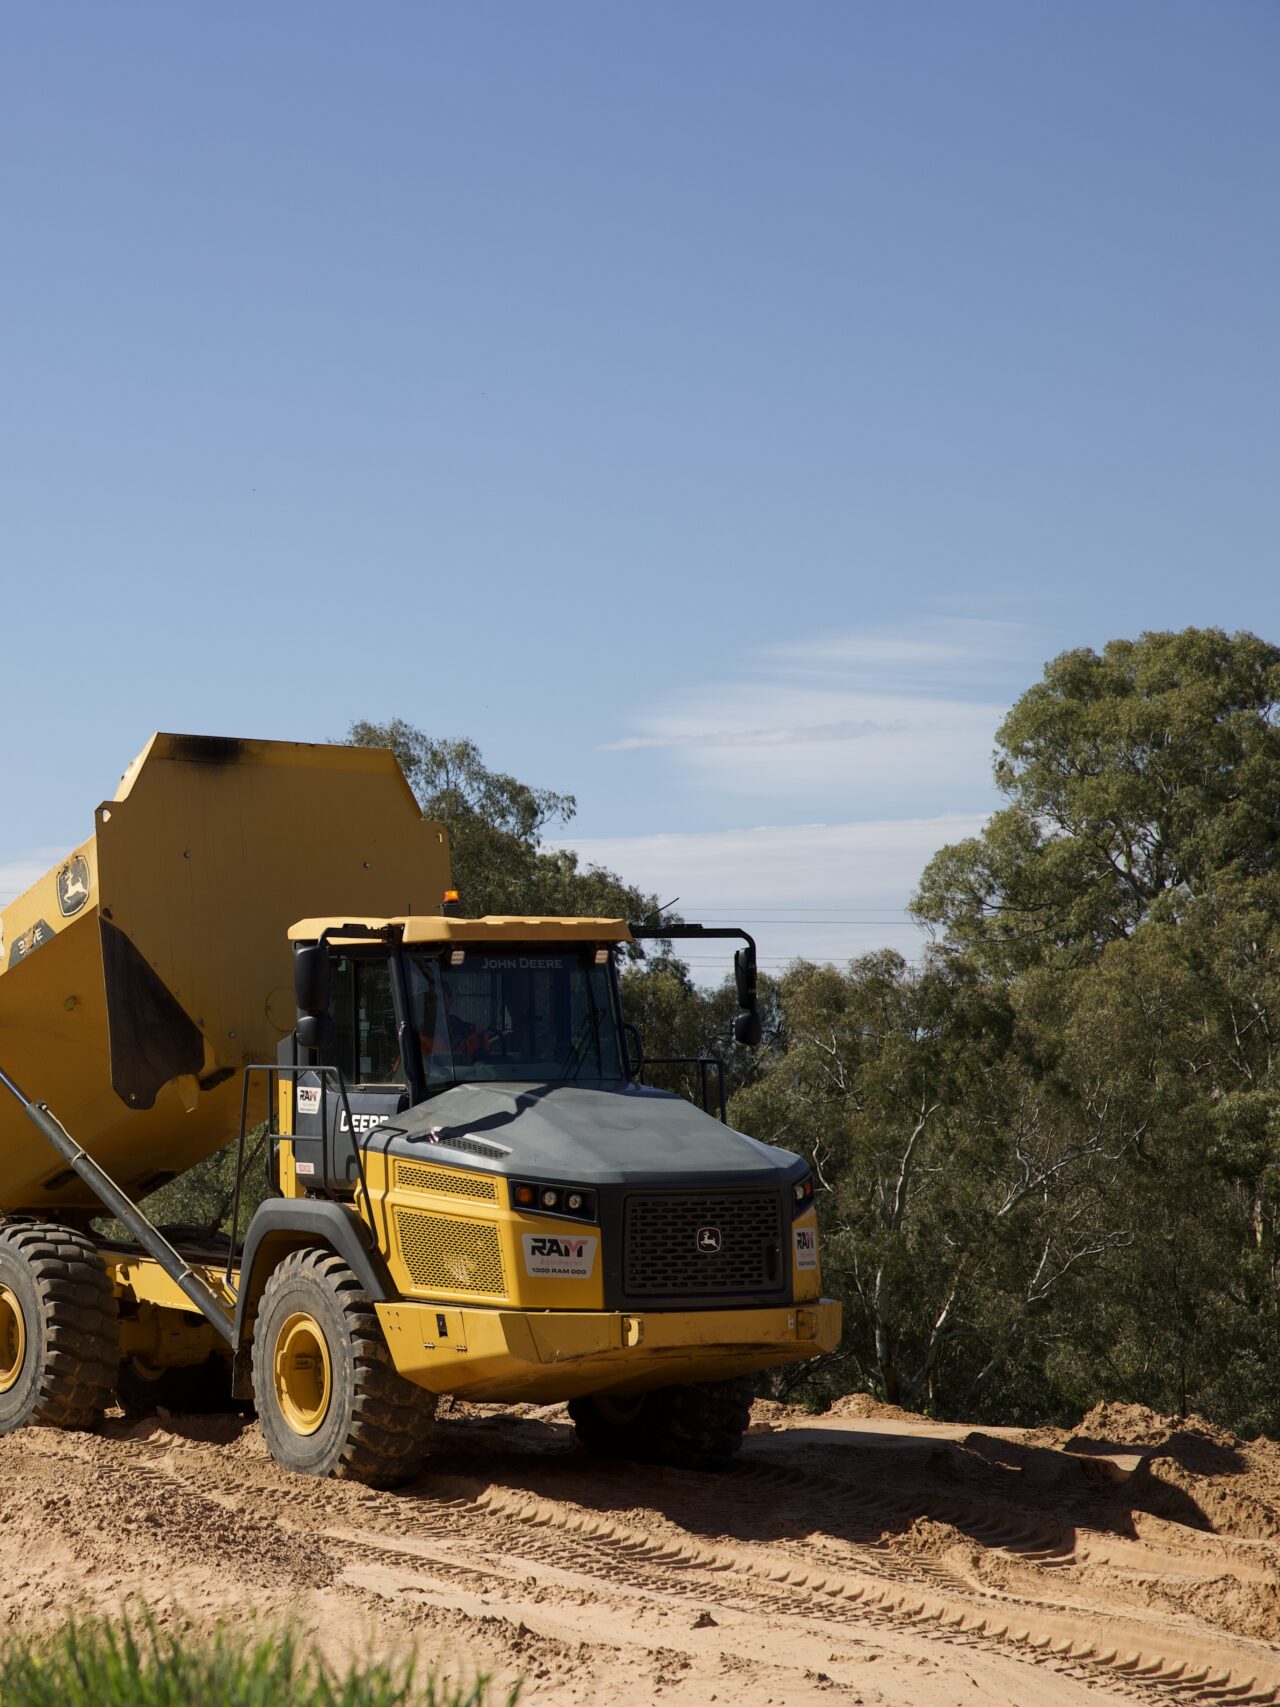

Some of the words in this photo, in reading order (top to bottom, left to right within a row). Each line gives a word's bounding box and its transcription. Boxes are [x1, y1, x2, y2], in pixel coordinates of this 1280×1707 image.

[17, 926, 44, 956] 3E
[481, 957, 517, 969] JOHN
[519, 957, 564, 969] DEERE
[299, 1090, 318, 1102] RAM
[530, 1238, 588, 1258] RAM
[796, 1231, 814, 1250] RAM
